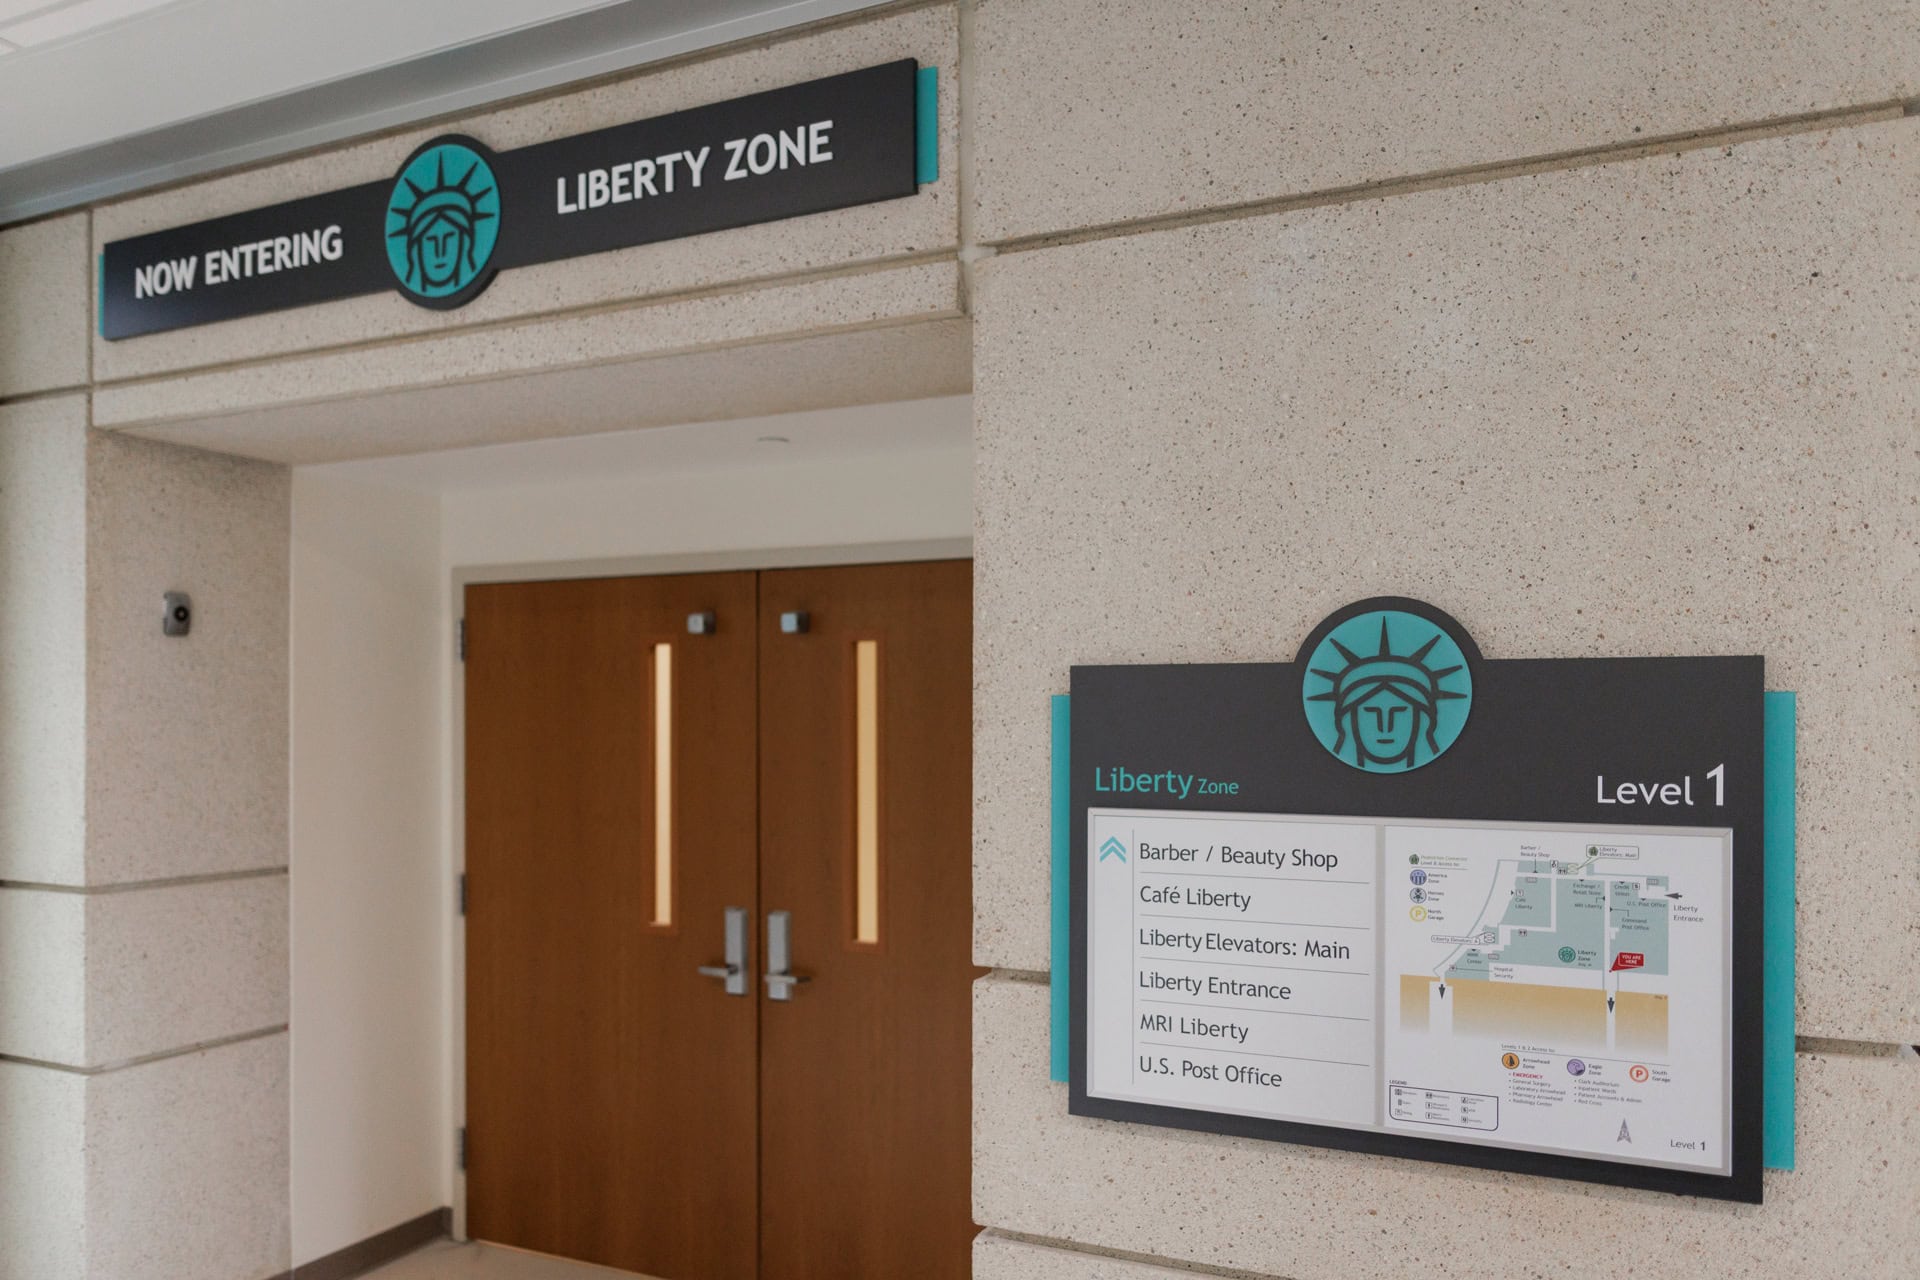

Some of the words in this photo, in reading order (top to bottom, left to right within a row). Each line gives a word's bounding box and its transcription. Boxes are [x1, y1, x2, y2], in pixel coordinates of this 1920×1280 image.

[135, 255, 197, 299] NOW
[205, 225, 343, 285] ENTERING
[557, 146, 711, 214] LIBERTY
[724, 120, 833, 181] ZONE
[1095, 767, 1193, 799] Liberty
[1197, 777, 1239, 795] Zone
[1597, 775, 1694, 806] Level
[1706, 763, 1724, 806] 1
[1140, 843, 1199, 862] Barber
[1205, 846, 1214, 862] /
[1221, 846, 1285, 869] Beauty
[1292, 849, 1338, 872] Shop
[1140, 885, 1180, 904] Café
[1187, 888, 1251, 911] Liberty
[1673, 905, 1698, 913] Liberty
[1673, 915, 1704, 923] Entrance
[1140, 928, 1202, 951] Liberty
[1206, 933, 1297, 956] Elevators:
[1304, 940, 1350, 960] Main
[1140, 971, 1202, 995] Liberty
[1208, 976, 1291, 1000] Entrance
[1140, 1014, 1173, 1033] MRI
[1180, 1017, 1248, 1043] Liberty
[1140, 1056, 1174, 1076] U.S.
[1182, 1060, 1219, 1081] Post
[1225, 1064, 1282, 1087] Office
[1670, 1139, 1696, 1150] Level
[1700, 1141, 1706, 1151] 1
